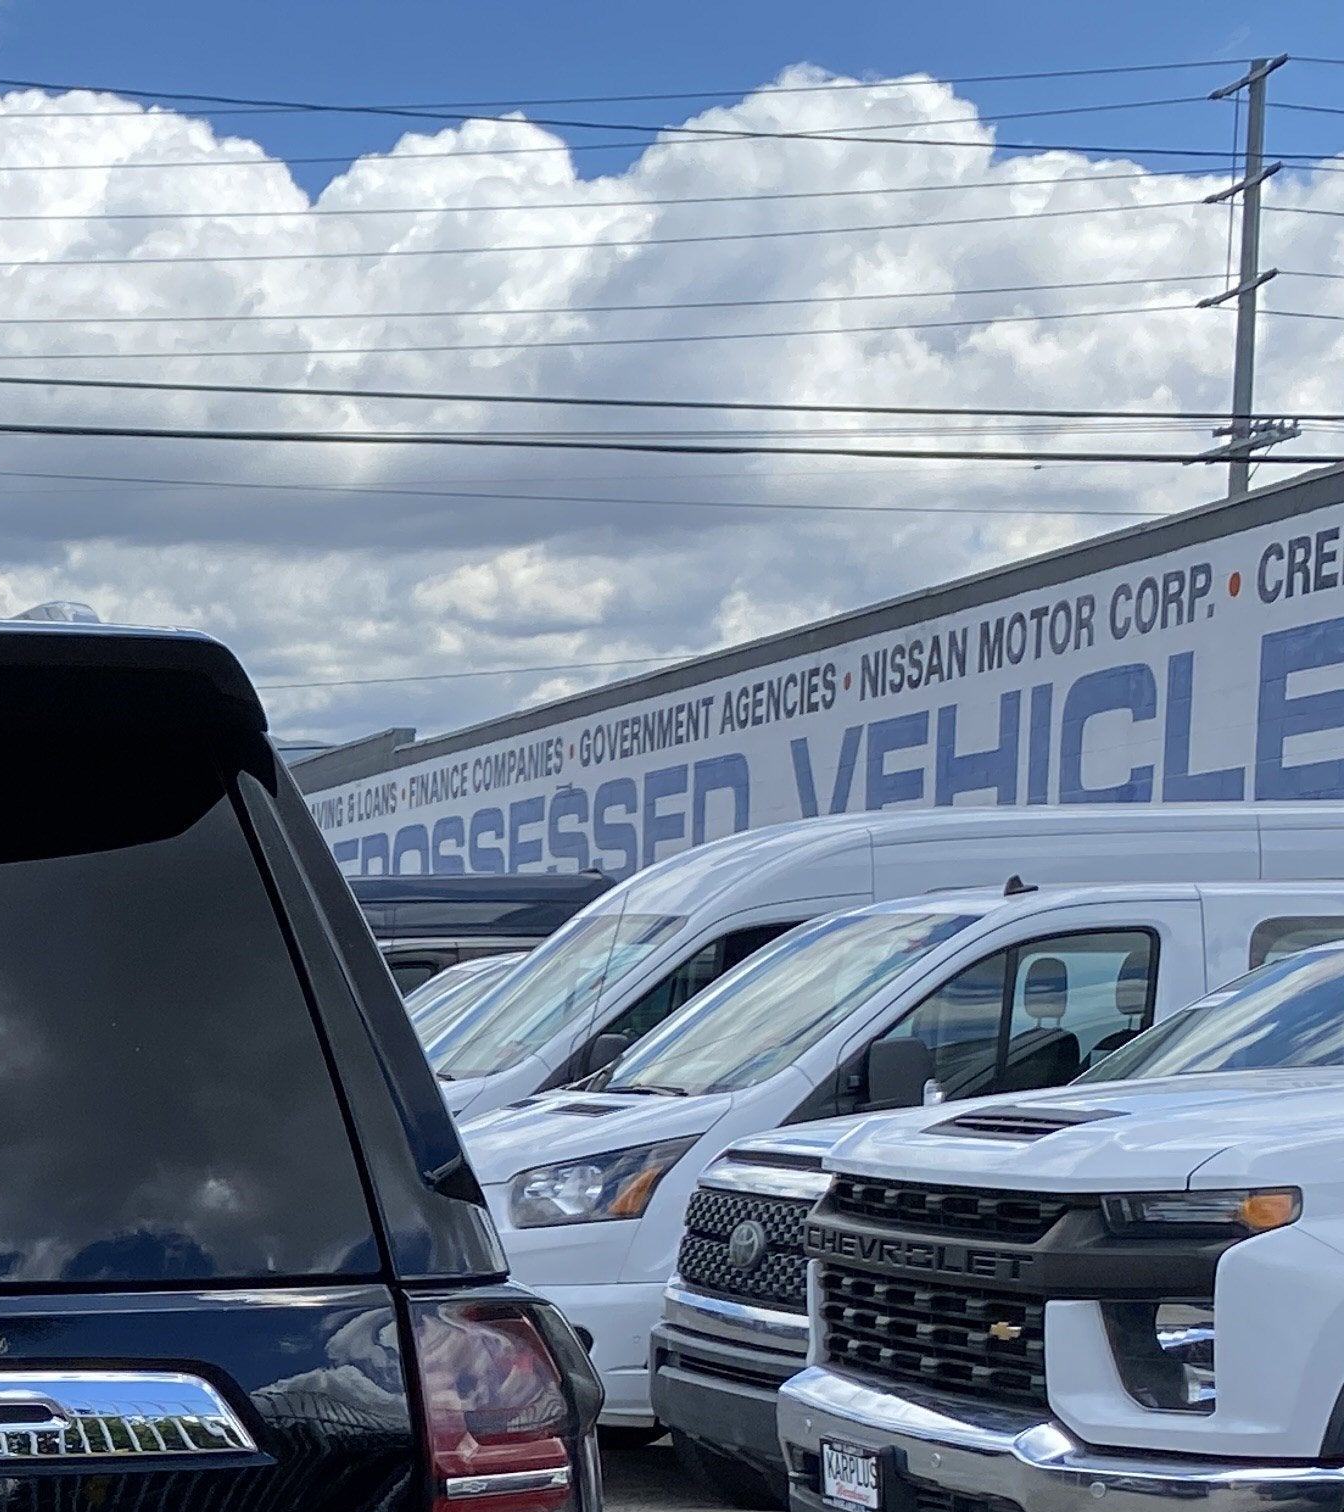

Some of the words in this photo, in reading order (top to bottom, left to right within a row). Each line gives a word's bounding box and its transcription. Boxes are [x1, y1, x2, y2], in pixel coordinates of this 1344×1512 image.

[348, 793, 355, 823] &
[358, 782, 397, 822] LOANS
[409, 762, 468, 810] FINANCE
[472, 737, 564, 793] COMPANIES
[579, 696, 714, 768] GOVERNMENT
[719, 663, 837, 734] AGENCIES
[860, 628, 968, 701] NISSAN
[978, 594, 1096, 673] MOTOR
[1111, 562, 1214, 641] CORP.
[1257, 526, 1344, 604] CRE
[808, 1226, 1034, 1281] CHEVROLET
[825, 1451, 877, 1489] KARPLUS
